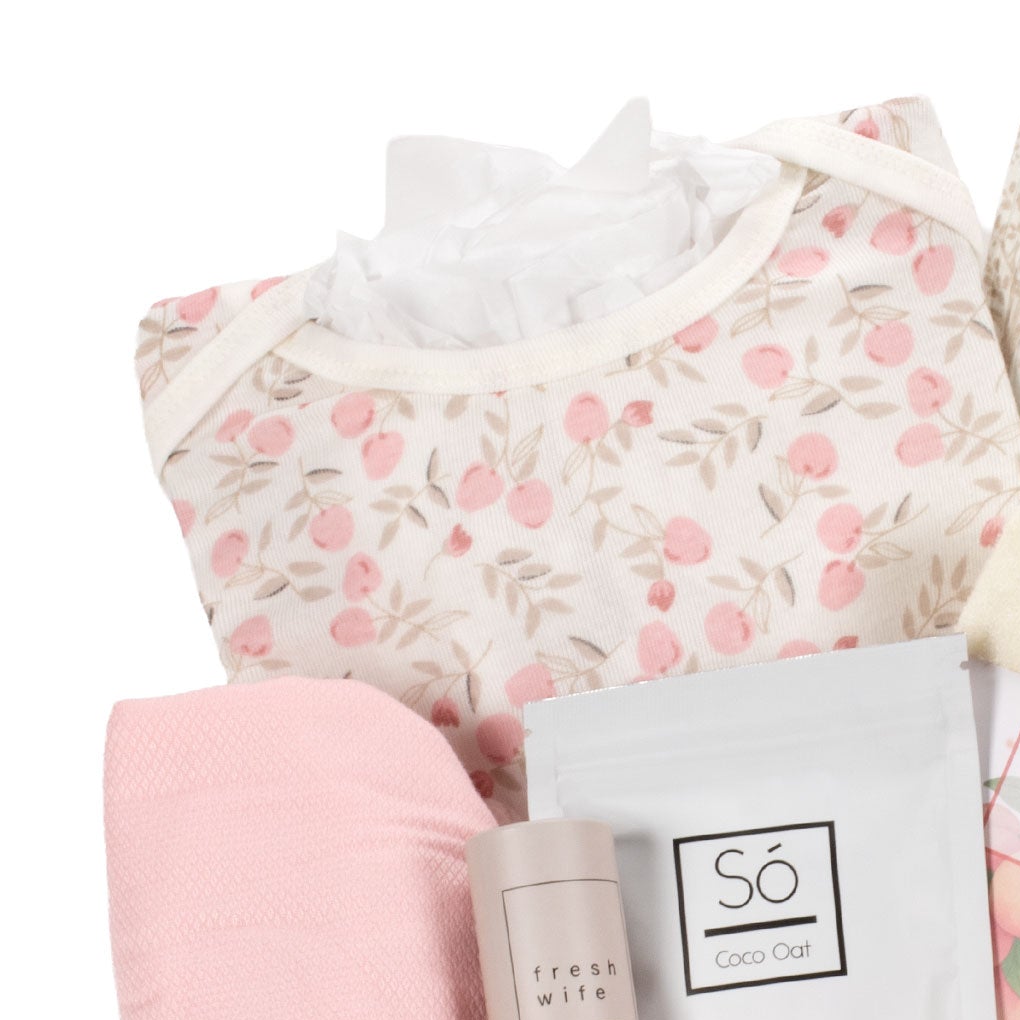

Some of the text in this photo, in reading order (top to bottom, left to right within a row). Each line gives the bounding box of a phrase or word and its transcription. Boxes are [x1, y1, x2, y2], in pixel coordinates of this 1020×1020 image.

[715, 843, 799, 909] Só
[715, 940, 812, 969] Coco Oat
[533, 959, 617, 983] fresh
[537, 984, 606, 1007] wife
